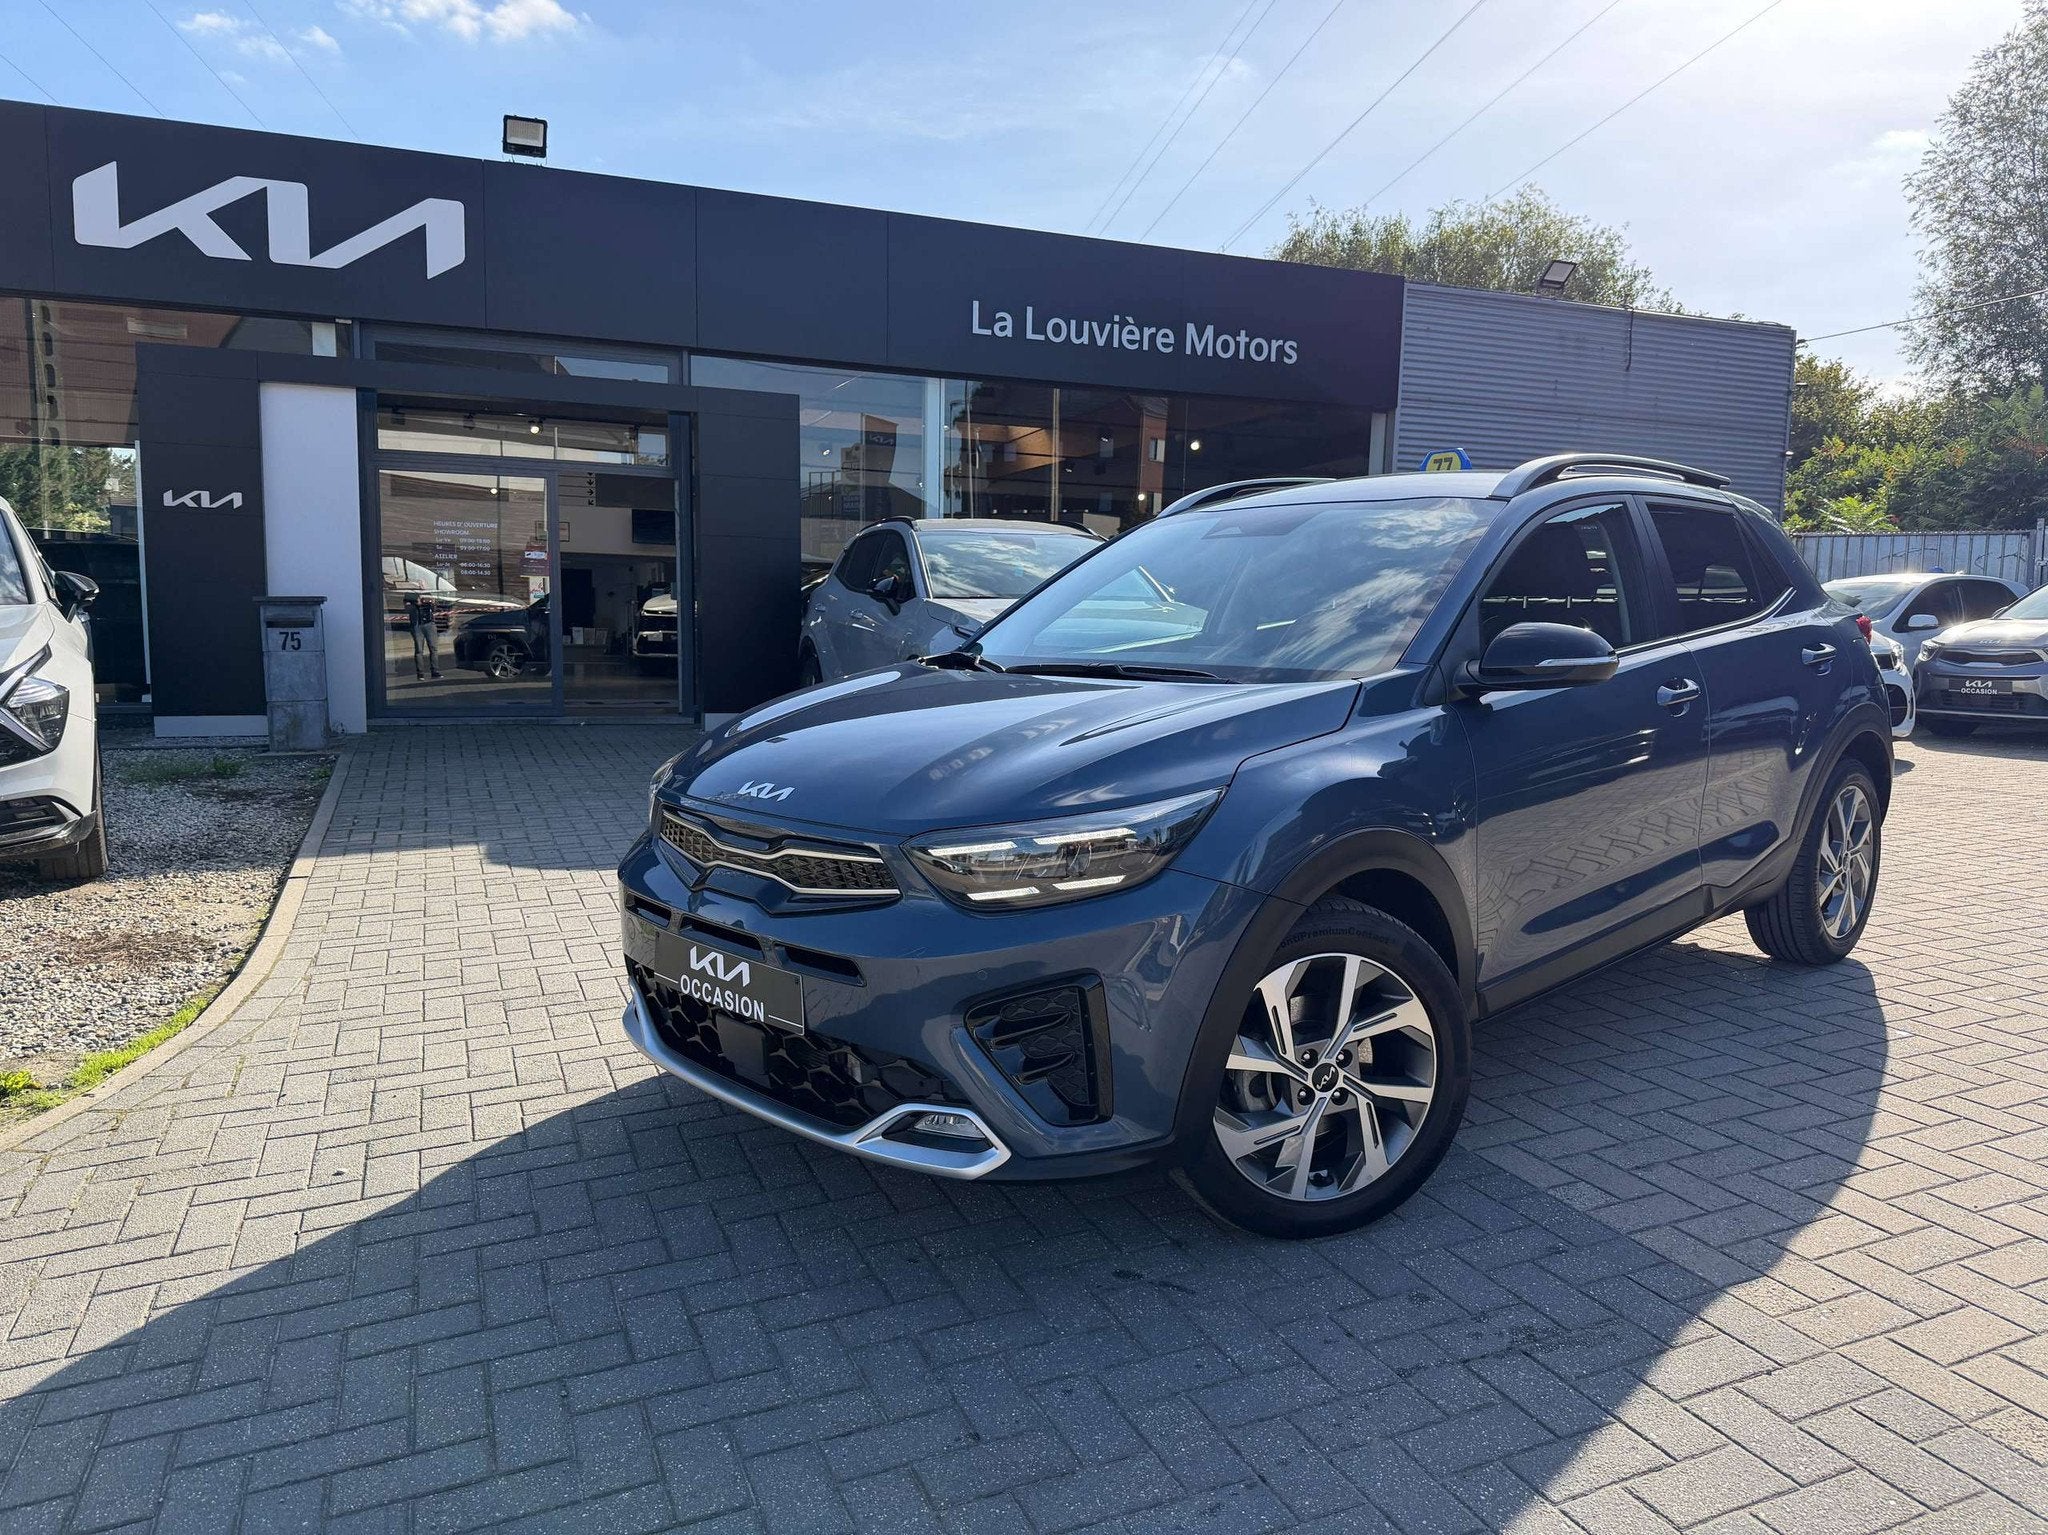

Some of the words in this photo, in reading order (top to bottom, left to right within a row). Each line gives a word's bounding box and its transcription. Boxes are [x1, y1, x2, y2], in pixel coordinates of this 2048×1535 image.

[72, 161, 465, 280] KIA
[972, 300, 1013, 338] La
[1025, 306, 1175, 353] Louvière
[1185, 322, 1298, 364] Motors
[1433, 456, 1453, 471] 77
[163, 489, 243, 509] KIA
[279, 631, 301, 651] 75
[1960, 687, 1998, 695] OCCASION
[737, 780, 796, 802] KIA
[689, 945, 751, 988] KIA
[680, 974, 765, 1023] OCCASION
